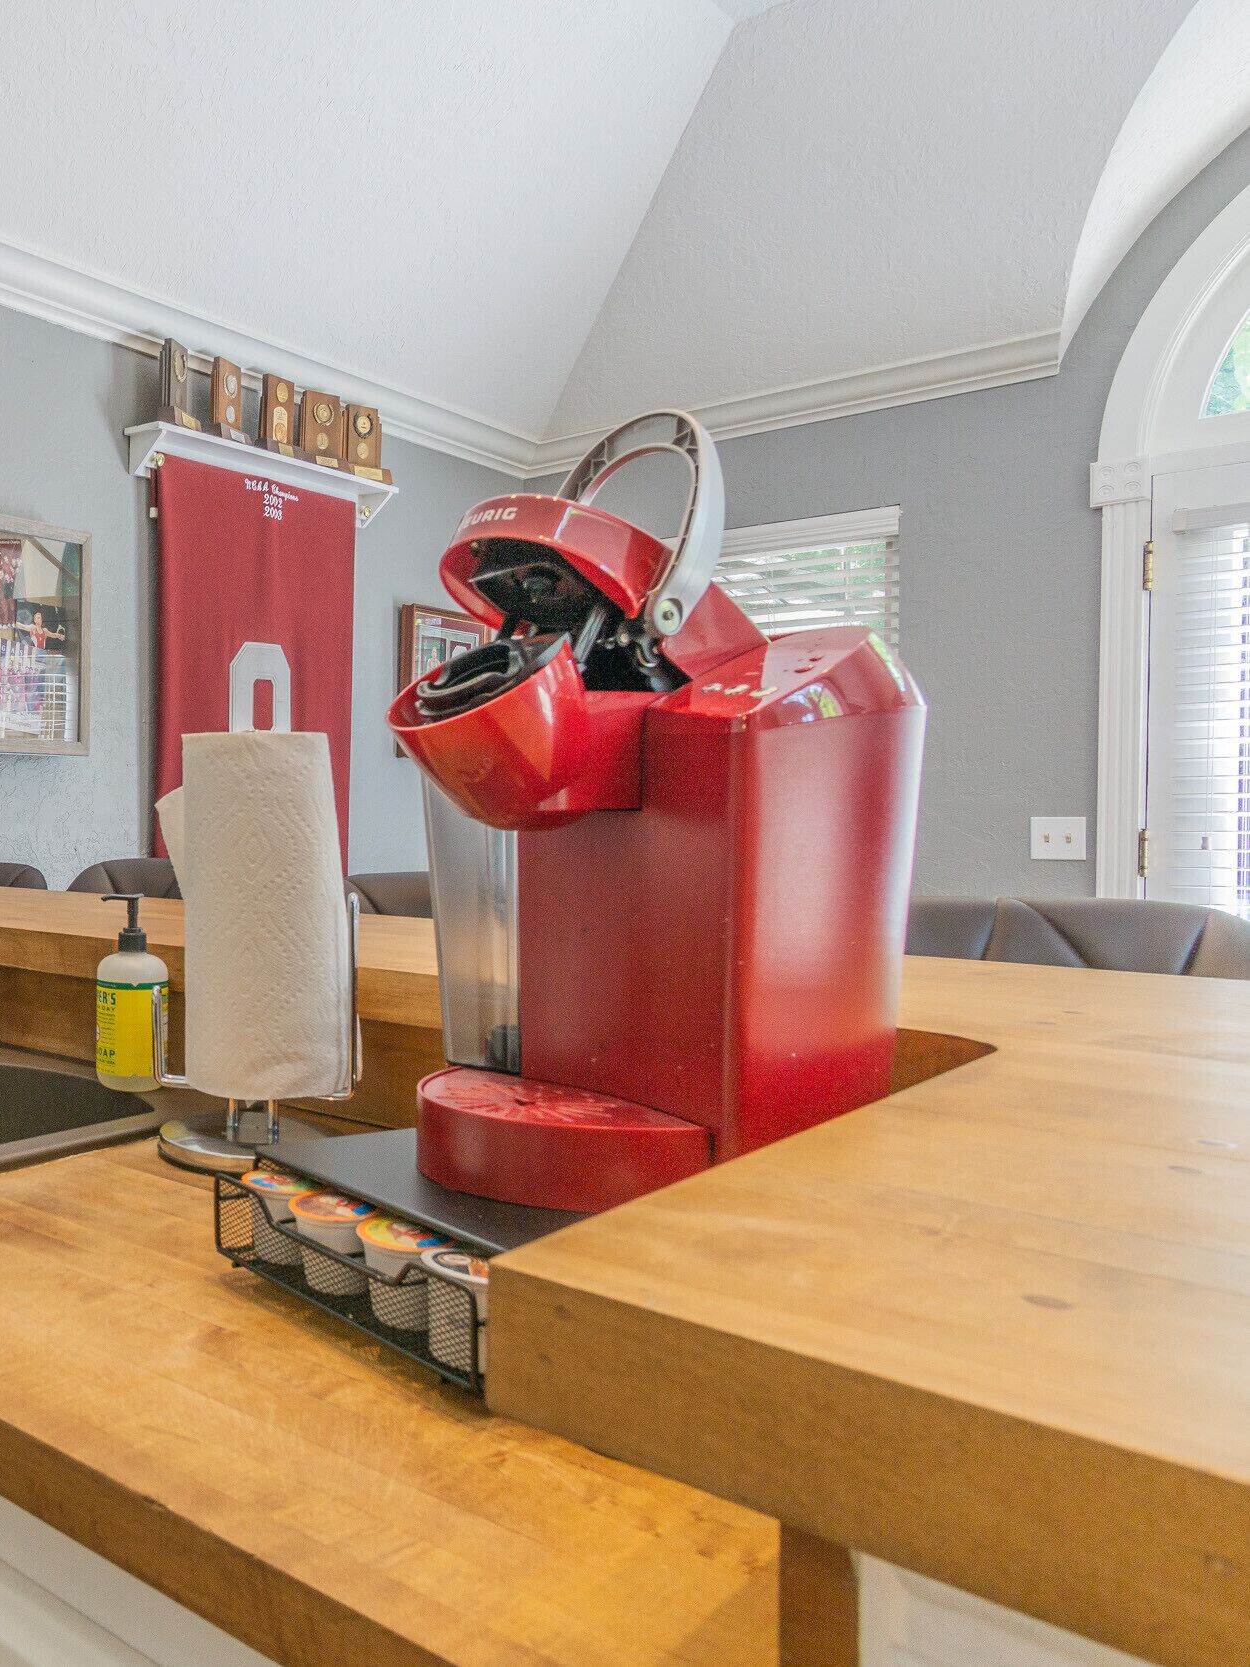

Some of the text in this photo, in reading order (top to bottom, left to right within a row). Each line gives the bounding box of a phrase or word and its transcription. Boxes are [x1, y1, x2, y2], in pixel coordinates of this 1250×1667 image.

[244, 478, 269, 492] NCAA
[262, 493, 283, 508] 2002
[96, 1046, 116, 1058] OAP
